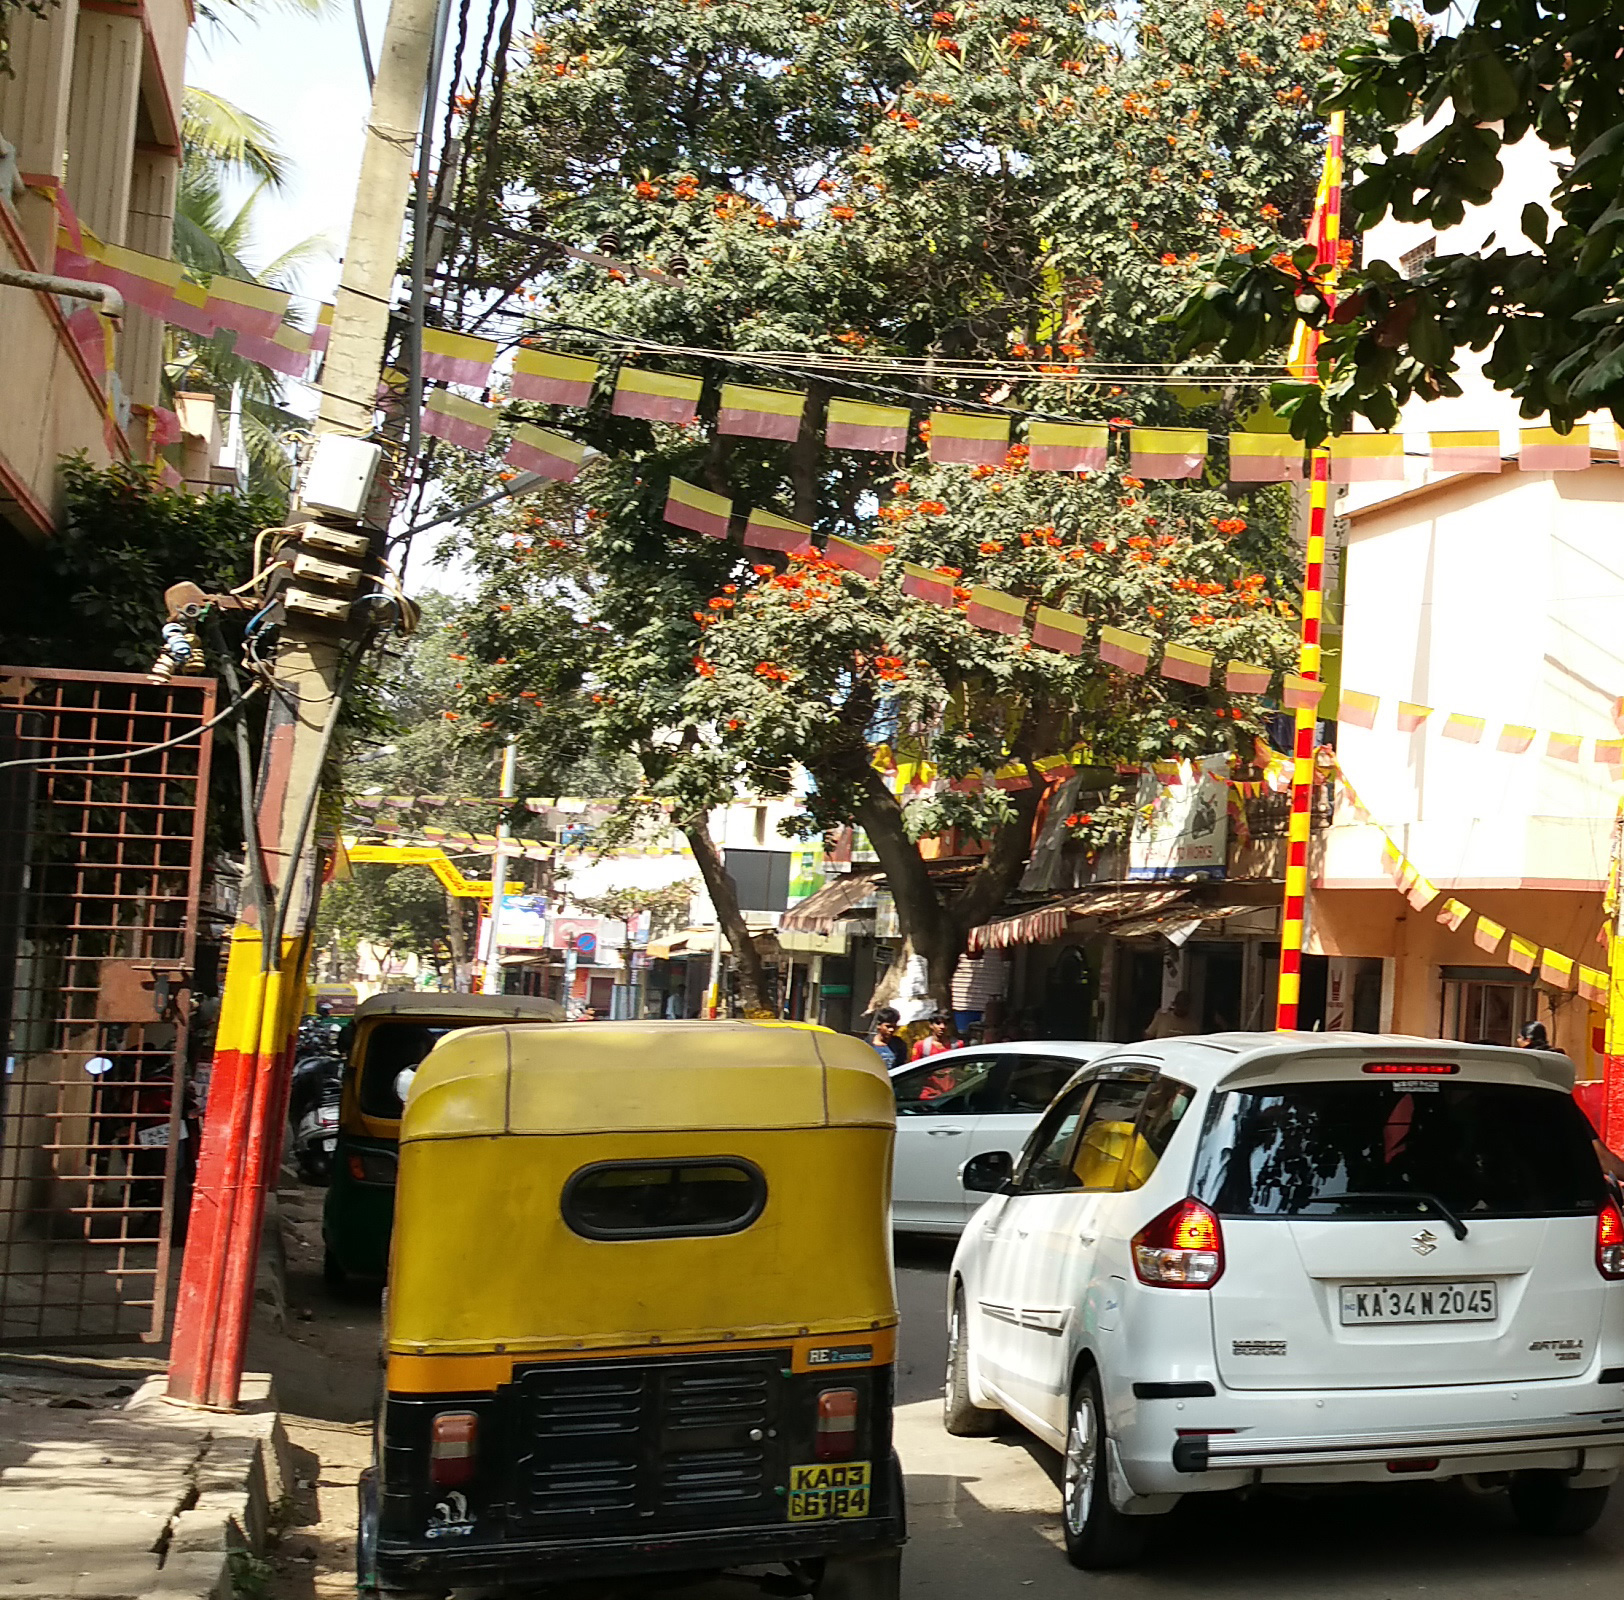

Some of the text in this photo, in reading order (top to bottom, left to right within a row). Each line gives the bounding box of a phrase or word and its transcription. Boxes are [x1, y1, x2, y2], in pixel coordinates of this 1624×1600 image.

[1357, 1293, 1384, 1317] KA
[1389, 1292, 1416, 1316] 34
[1439, 1289, 1493, 1315] 2045
